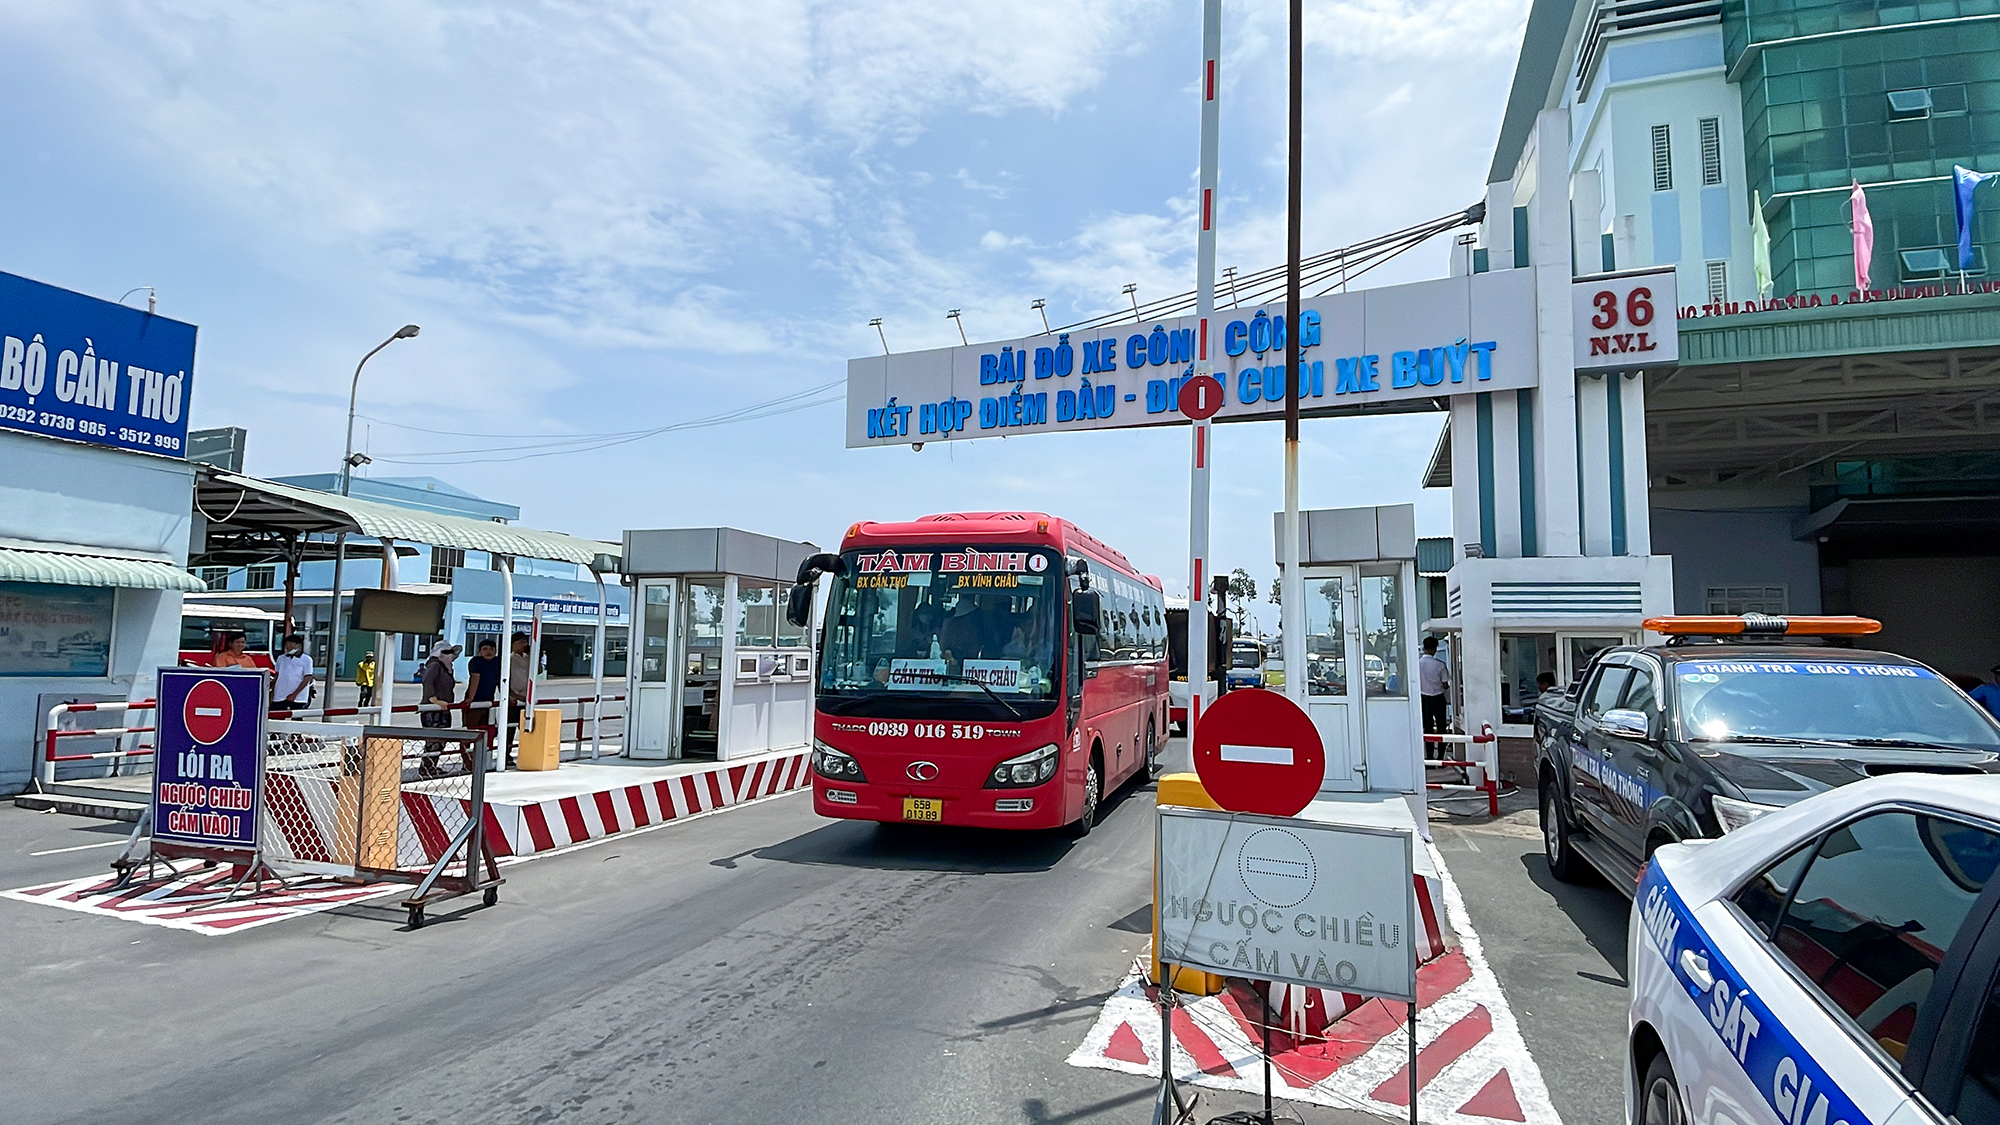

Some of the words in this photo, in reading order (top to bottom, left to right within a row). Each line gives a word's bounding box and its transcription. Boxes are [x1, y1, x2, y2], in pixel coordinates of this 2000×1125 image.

[1591, 287, 1655, 330] 36
[980, 346, 1027, 386] BÃI
[1034, 333, 1074, 380] ĐỖ
[1082, 338, 1117, 374] XE
[1126, 324, 1196, 369] CÔN
[1225, 309, 1322, 361] CỘNG
[1590, 331, 1658, 357] N.V.L
[0, 333, 47, 405] BỘ
[55, 337, 119, 411] CẦN
[127, 364, 185, 424] THƠ
[867, 396, 913, 439] KẾT
[919, 395, 972, 438] HỢP
[979, 382, 1048, 429] ĐIỂM
[1056, 377, 1116, 423] ĐẦU
[1335, 353, 1379, 396] XE
[1392, 336, 1497, 390] BUÝT
[0, 404, 36, 424] 0292
[39, 411, 75, 431] 3738
[78, 420, 107, 437] 985
[119, 427, 151, 445] 3512
[154, 434, 180, 450] 999
[856, 549, 934, 573] TÂM
[938, 547, 1029, 573] BÌNH
[857, 576, 869, 588] BX
[958, 575, 970, 588] BX
[994, 572, 1018, 588] CHÂU
[990, 665, 1018, 687] CHÂU
[1695, 664, 1757, 674] THANH
[1759, 664, 1798, 674] TRA
[1805, 665, 1850, 676] GIAO
[1851, 664, 1919, 678] THÔNG
[868, 721, 909, 738] 0939
[914, 723, 946, 739] 016
[951, 724, 984, 740] 519
[986, 729, 1021, 738] TOWN
[177, 745, 205, 779] LỐI
[210, 754, 233, 780] RA
[160, 782, 206, 809] NGƯỢC
[208, 781, 252, 811] CHIỀU
[1618, 775, 1644, 808] THÔNG
[168, 806, 200, 834] CẤM
[201, 811, 231, 836] VÀO
[906, 810, 937, 820] 013.89
[1170, 894, 1284, 936] NGƯỢC
[1293, 911, 1400, 950] CHIỀU
[1208, 936, 1280, 975] CẤM
[1290, 949, 1358, 986] VÀO
[1644, 885, 1681, 958] CẢNH
[1709, 979, 1761, 1064] SÁT
[1773, 1056, 1850, 1125] GIA
